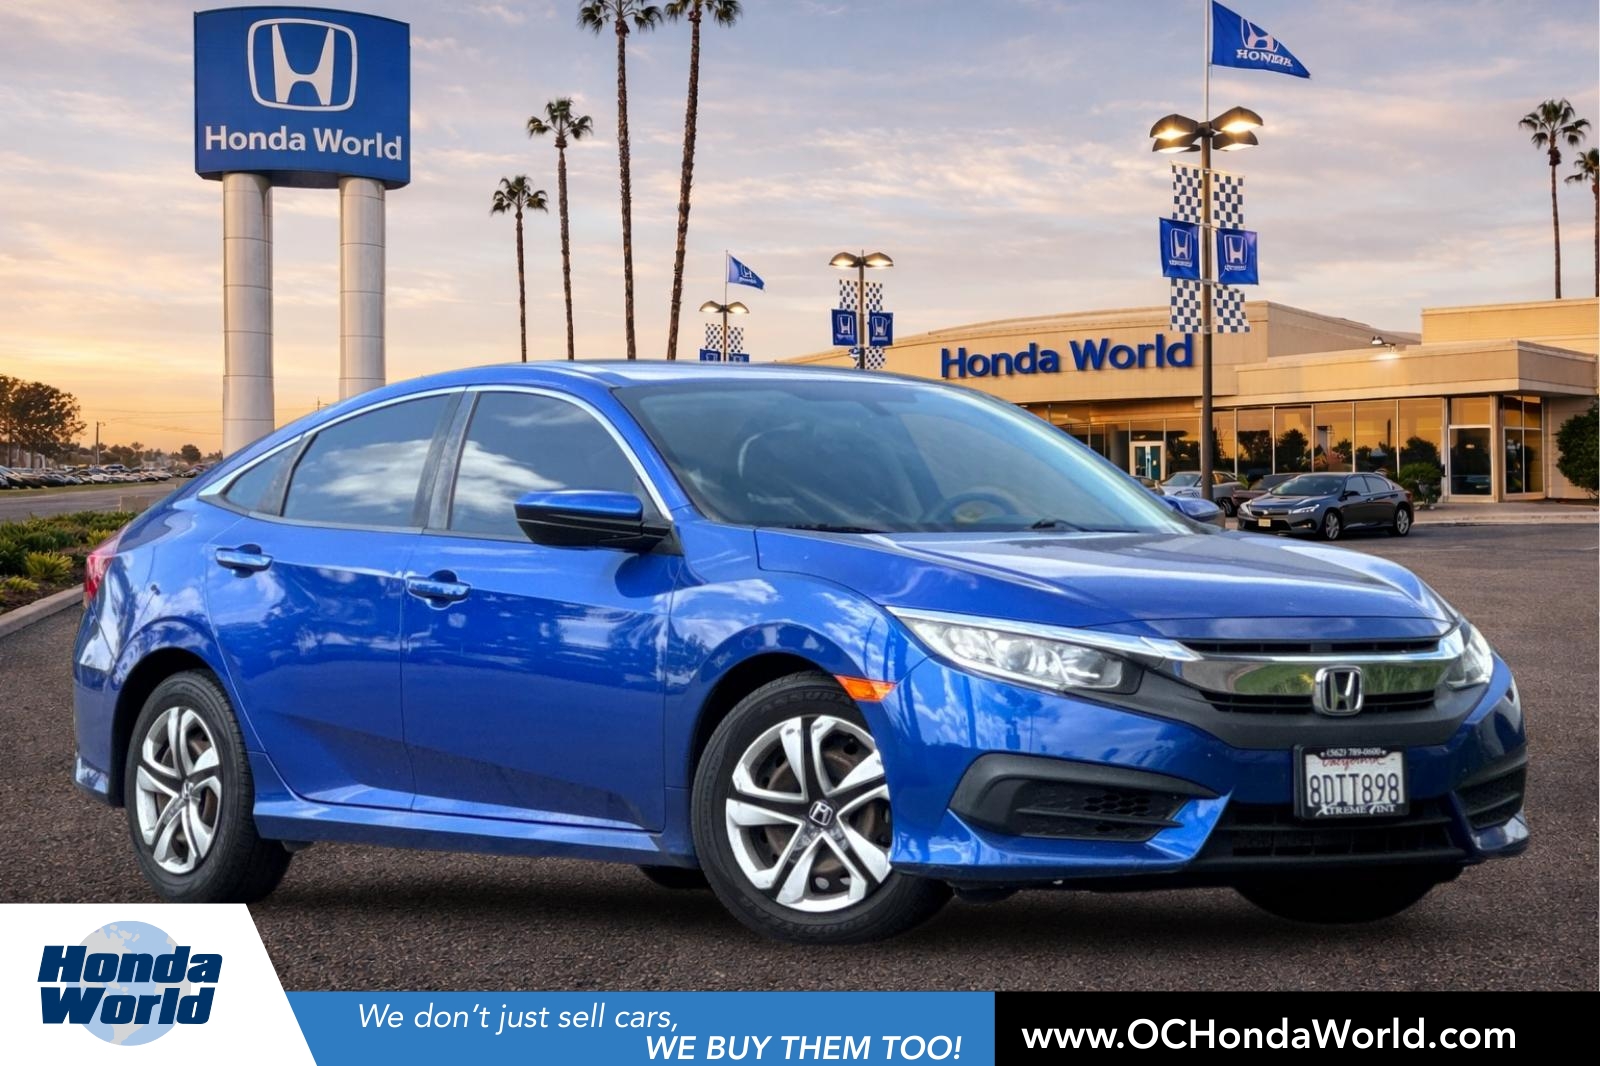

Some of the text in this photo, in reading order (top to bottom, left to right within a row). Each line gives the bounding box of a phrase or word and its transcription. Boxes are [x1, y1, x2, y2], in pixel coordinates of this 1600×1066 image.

[205, 125, 402, 160] Honda World
[941, 334, 1194, 377] Honda World
[1315, 803, 1367, 816] XTREME
